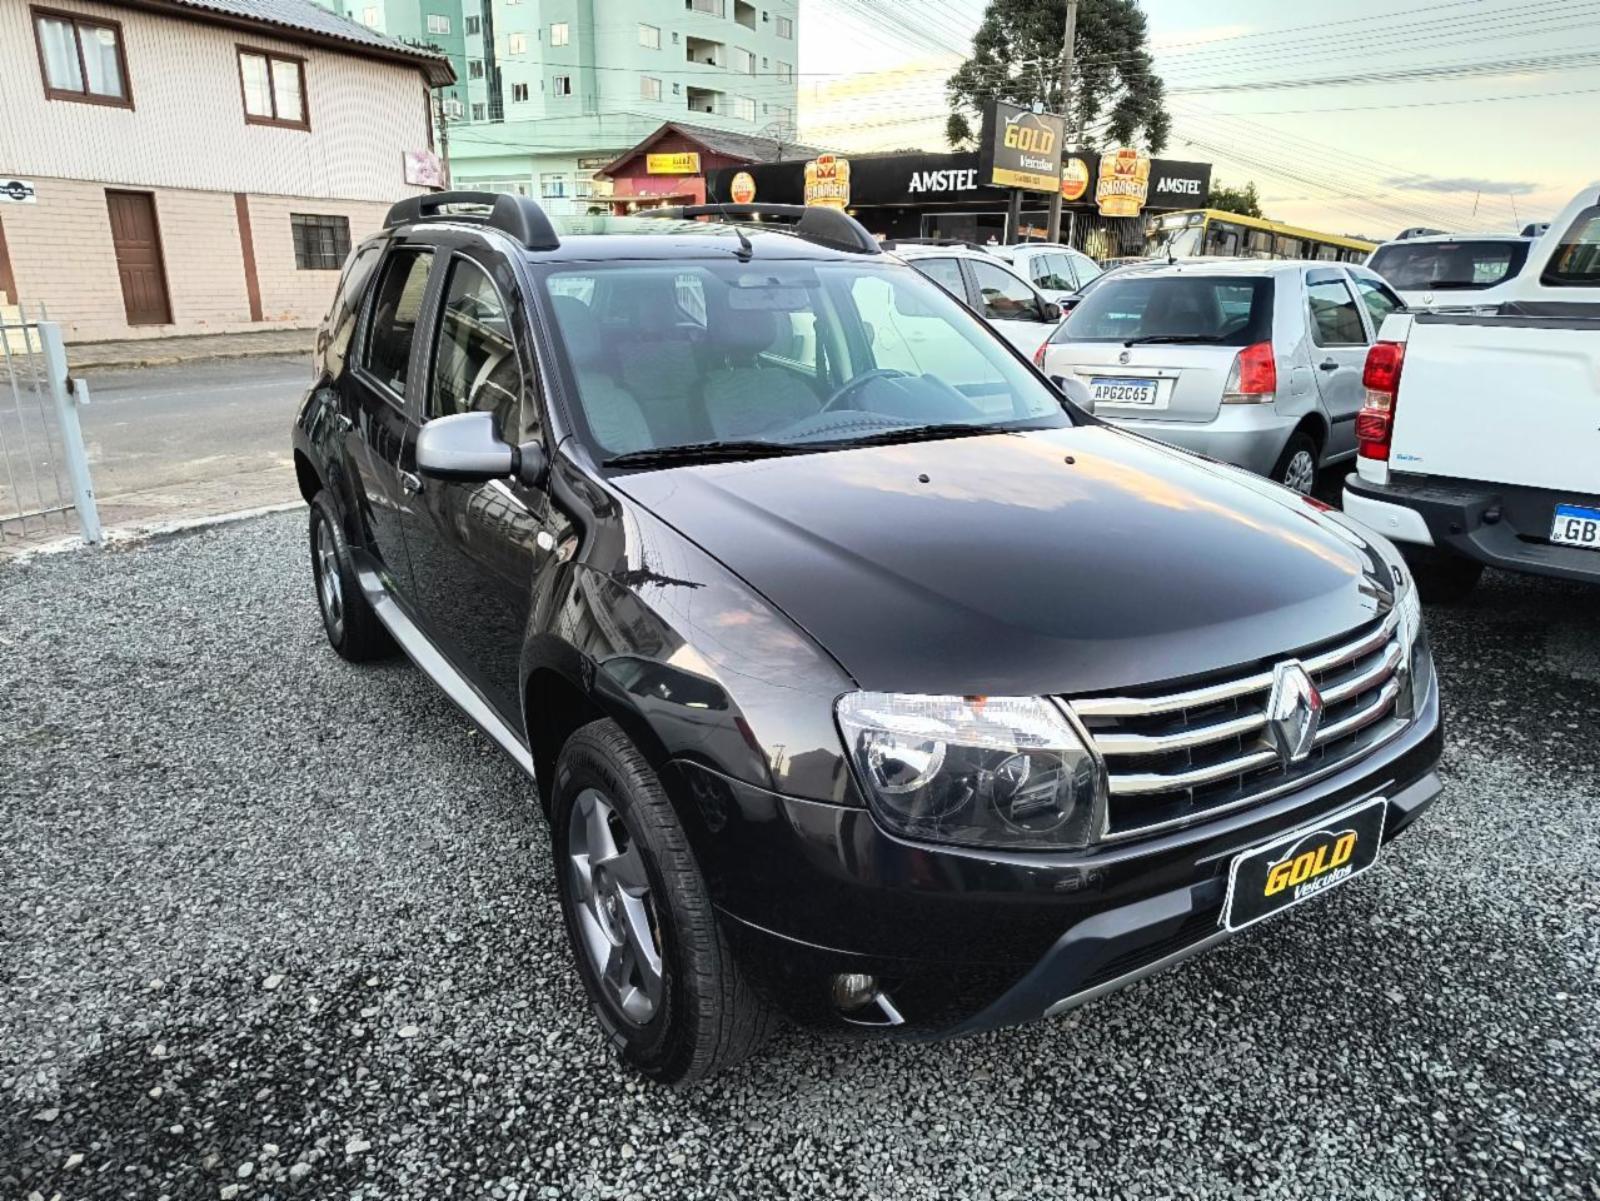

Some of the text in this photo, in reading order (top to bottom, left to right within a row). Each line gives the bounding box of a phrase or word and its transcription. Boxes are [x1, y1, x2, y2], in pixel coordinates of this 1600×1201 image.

[1004, 124, 1055, 154] GOLD
[908, 169, 978, 193] AMSTEL
[1156, 177, 1201, 195] AMSTEL
[1095, 386, 1148, 401] APG2C65
[1264, 832, 1356, 897] GOLD
